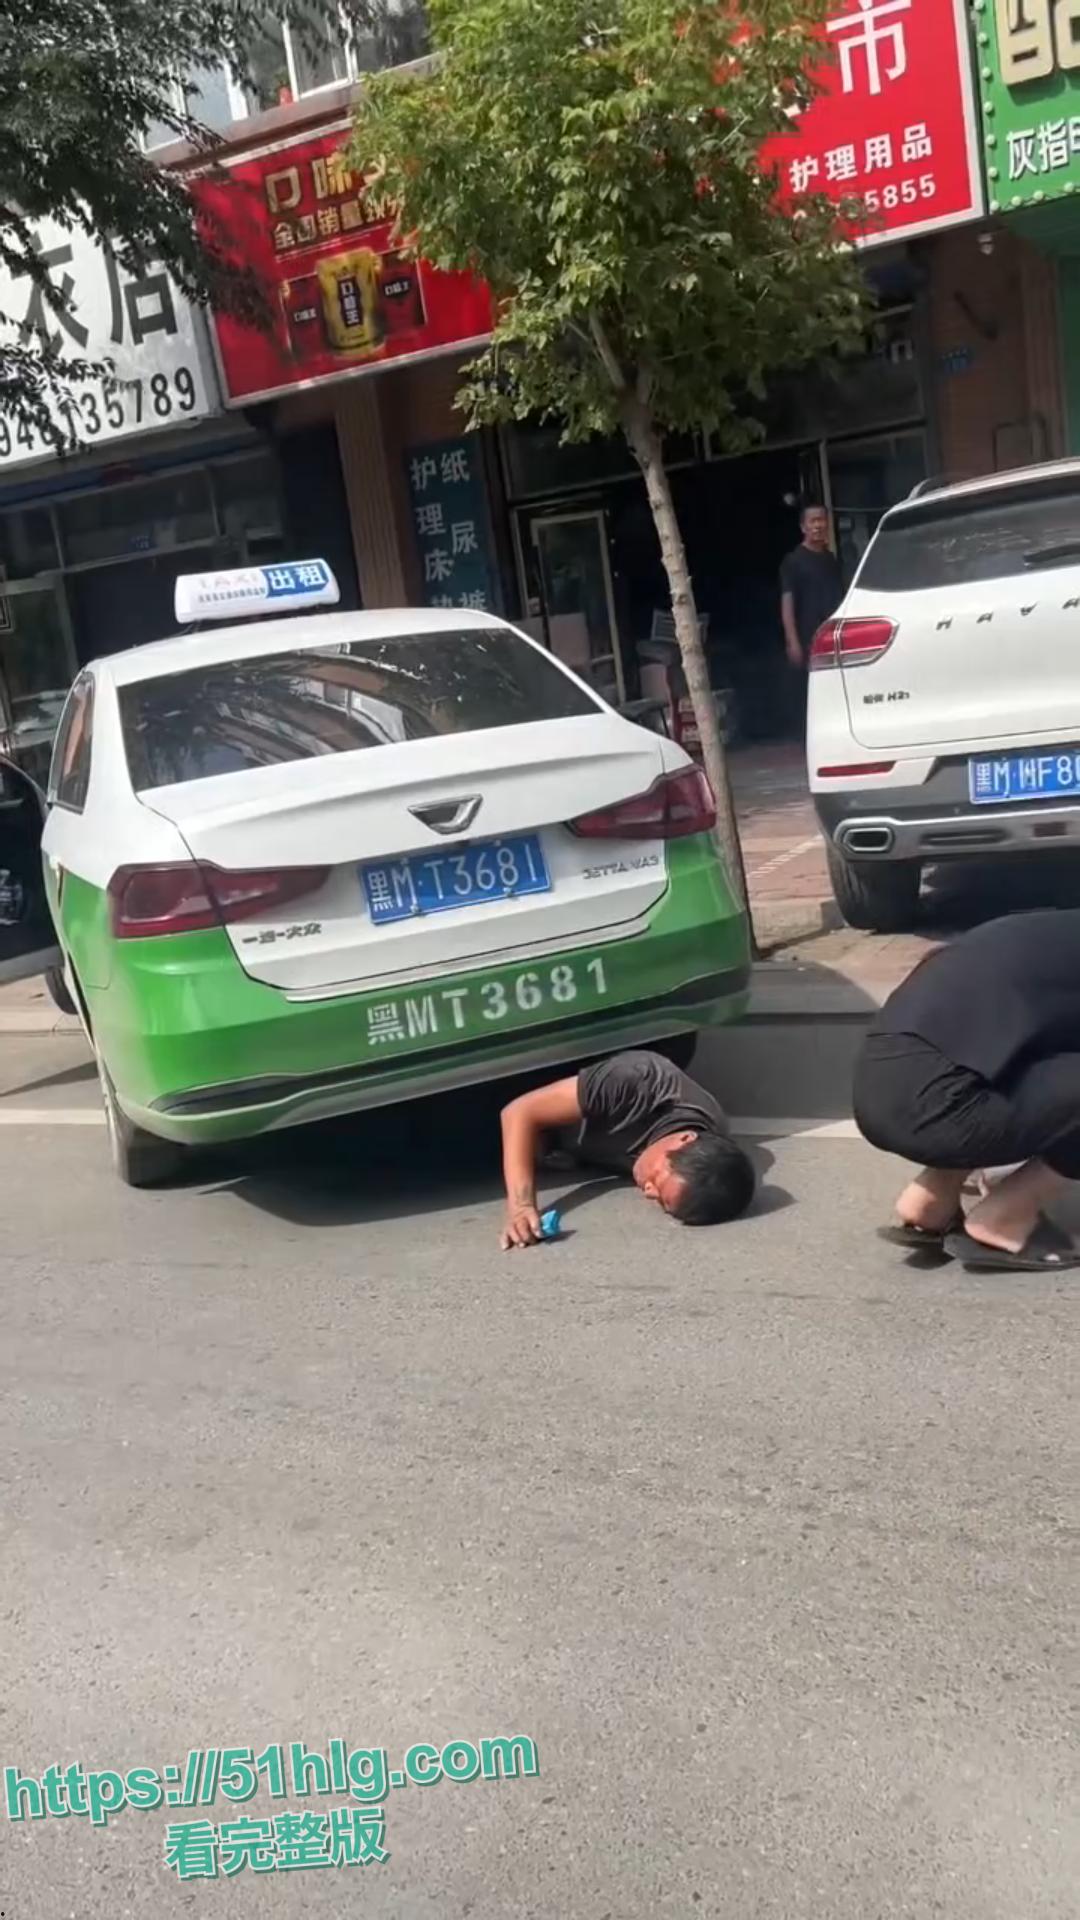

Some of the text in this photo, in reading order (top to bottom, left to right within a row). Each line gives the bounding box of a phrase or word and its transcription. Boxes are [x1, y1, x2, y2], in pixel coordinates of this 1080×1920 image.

[826, 0, 913, 96] 市
[265, 150, 388, 213] 口味
[788, 122, 933, 193] 护理用品
[268, 564, 325, 590] 出租
[367, 957, 608, 1045] 黑MT3681
